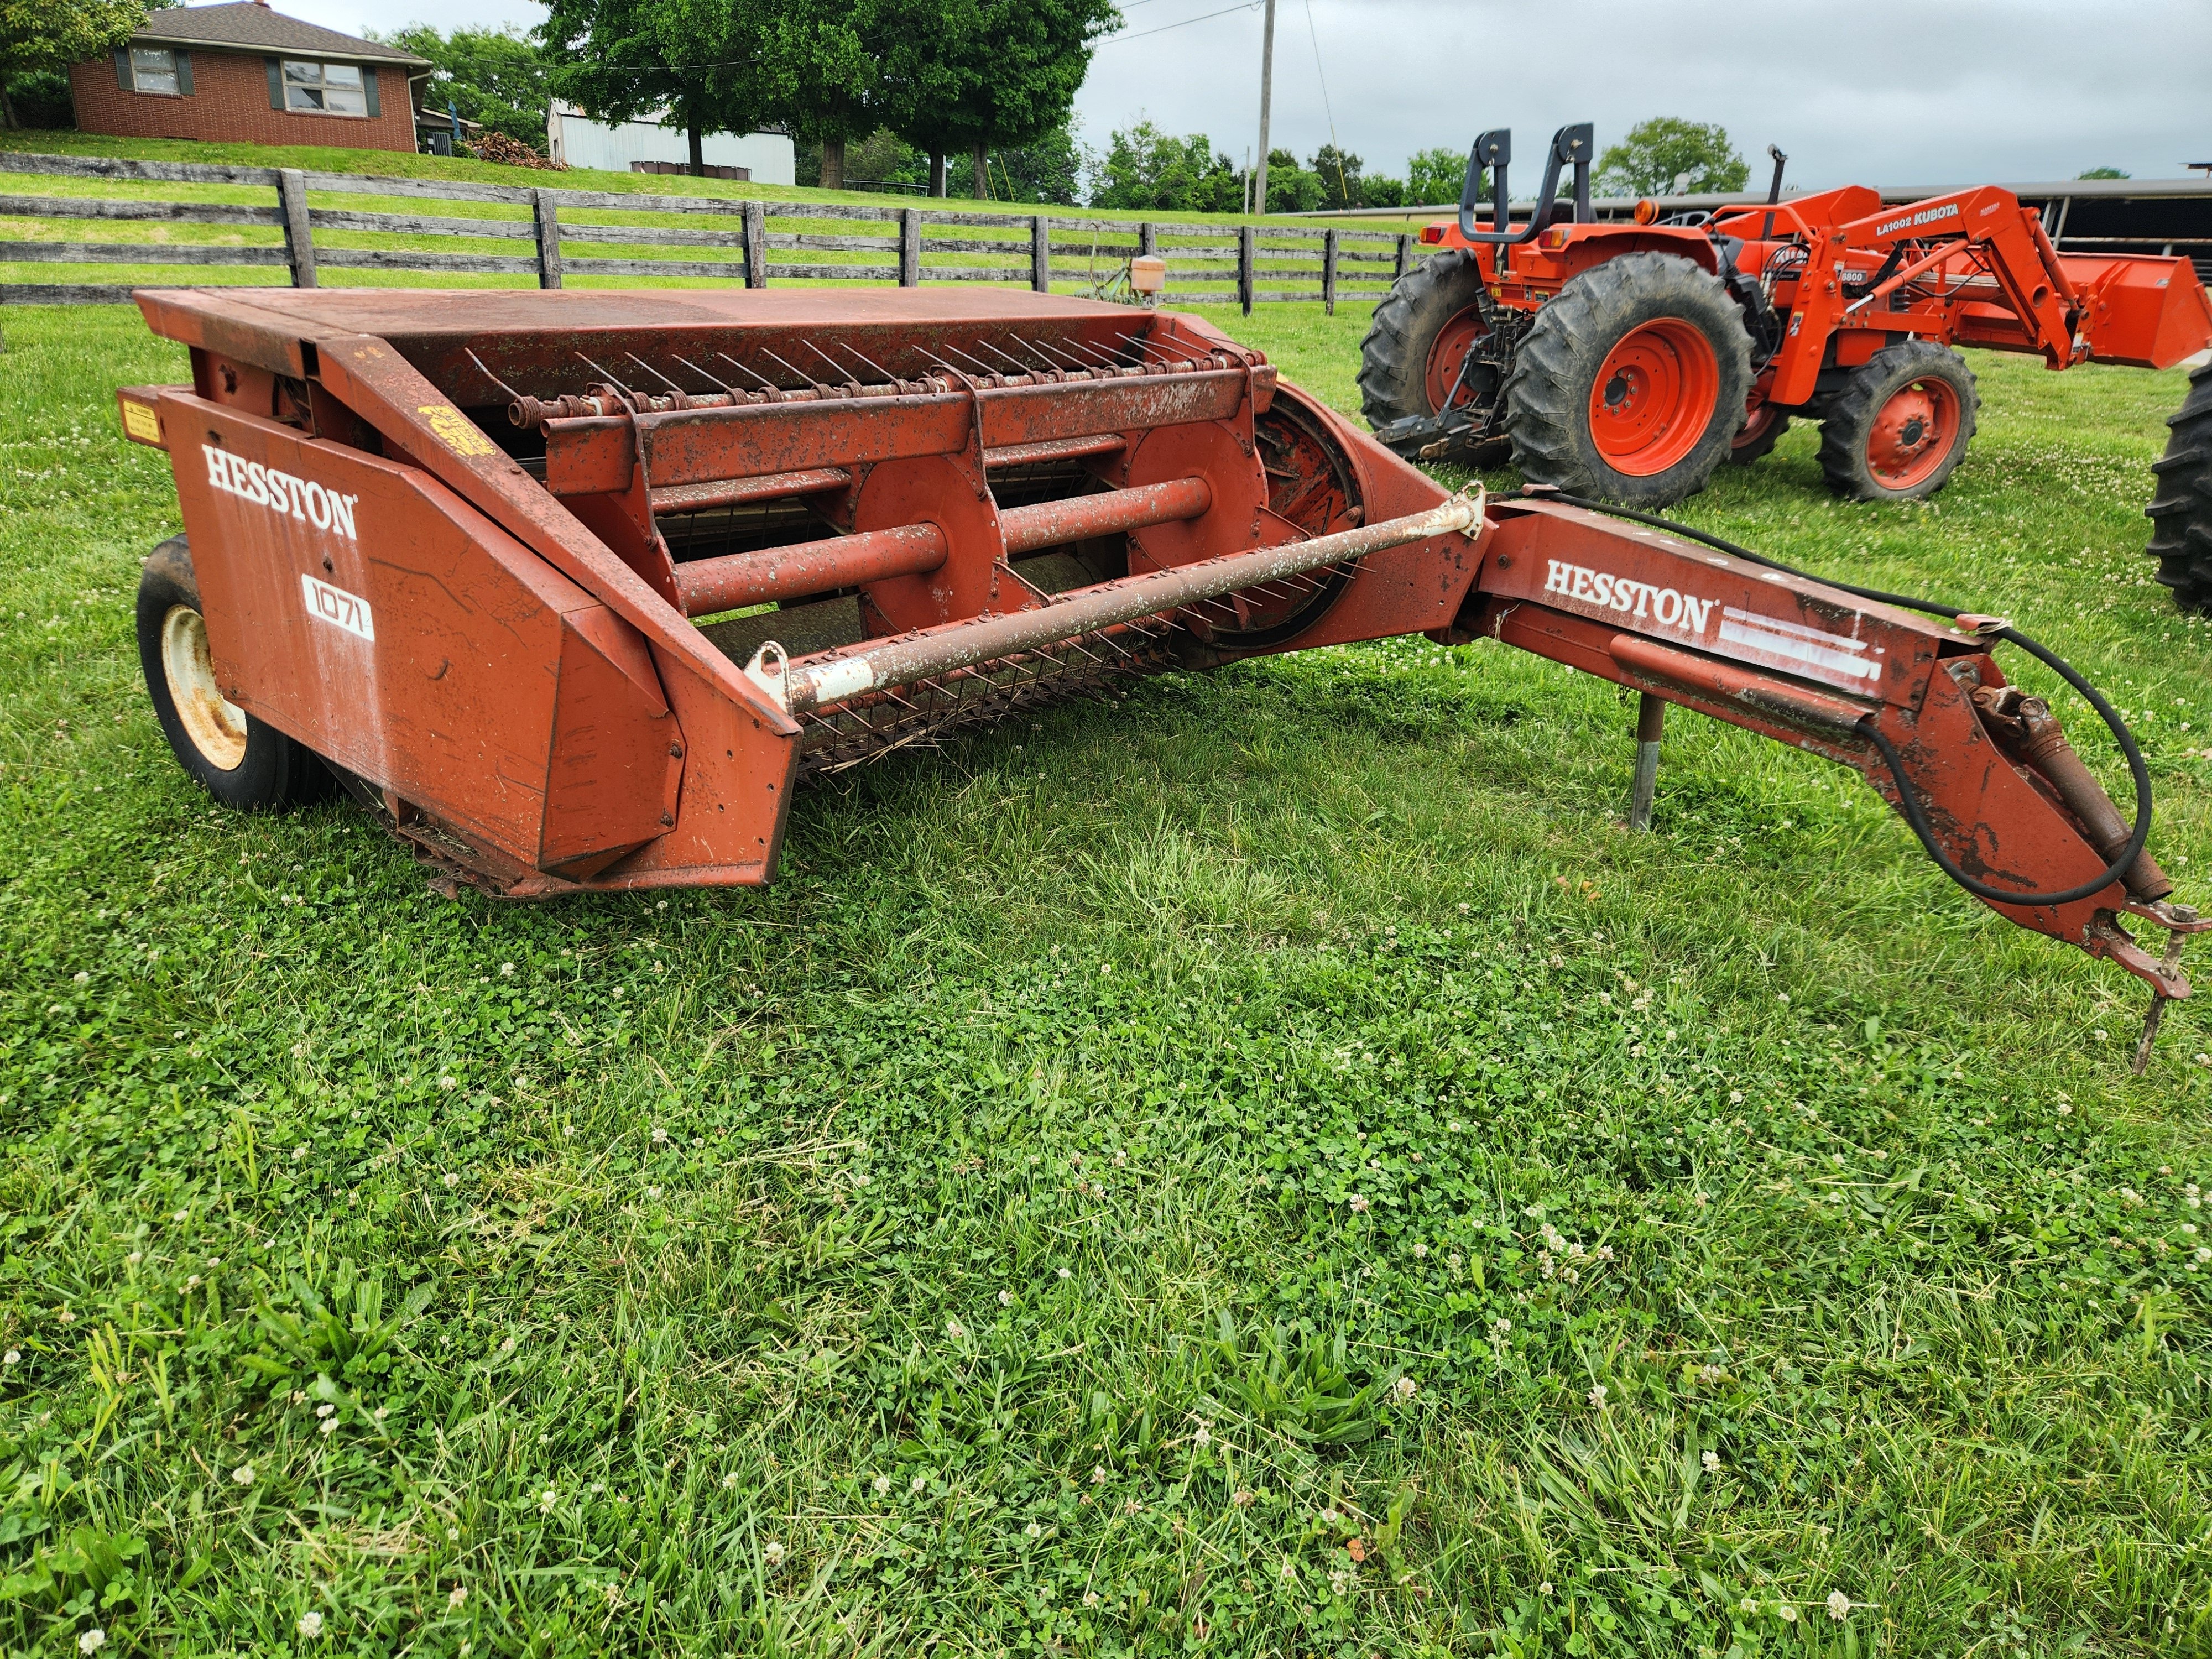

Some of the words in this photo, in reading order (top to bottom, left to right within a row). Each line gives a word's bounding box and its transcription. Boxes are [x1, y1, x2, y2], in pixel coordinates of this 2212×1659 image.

[1876, 216, 1912, 236] LA1002
[1914, 203, 1959, 226] KUBOTA
[1842, 273, 1863, 281] 6800
[201, 444, 358, 540] HESSTON
[311, 582, 364, 632] 1071
[1544, 559, 1714, 634] HESSTON
